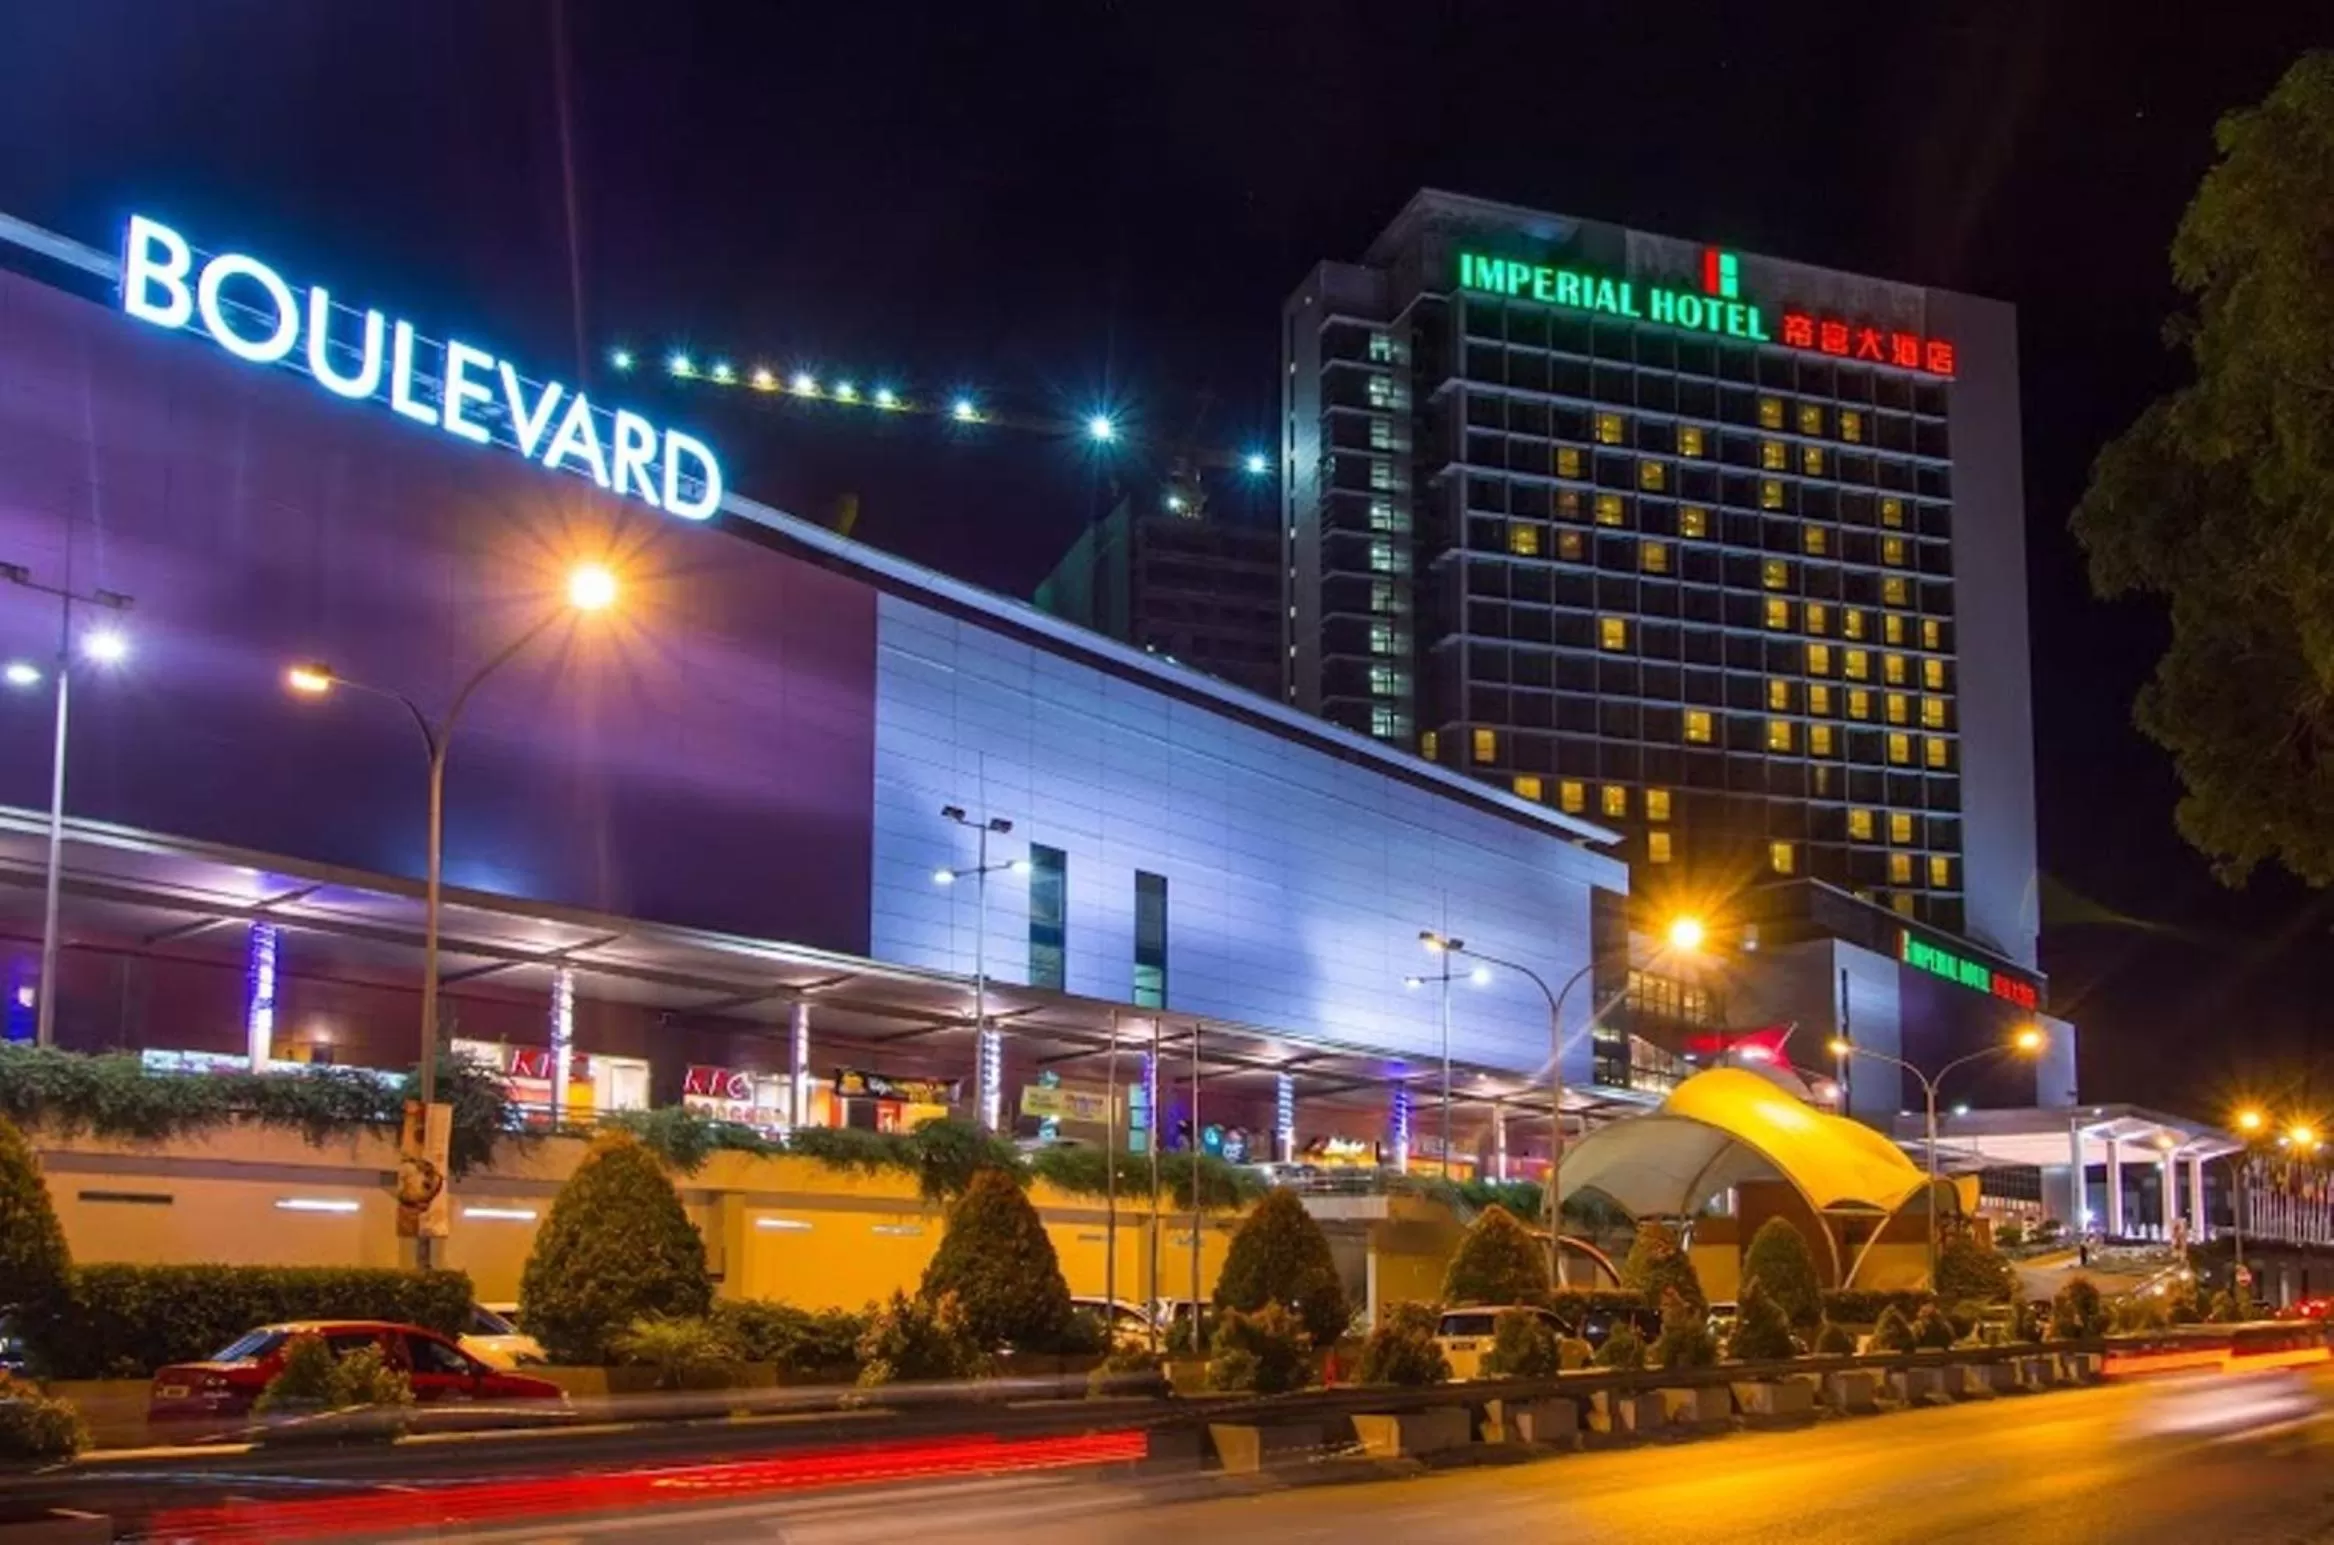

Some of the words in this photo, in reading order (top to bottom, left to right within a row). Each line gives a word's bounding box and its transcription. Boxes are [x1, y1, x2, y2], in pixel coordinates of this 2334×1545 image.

[123, 213, 723, 521] BOULEVARD
[1460, 252, 1642, 318] IMPERIAL
[1650, 287, 1771, 341] HOTEL
